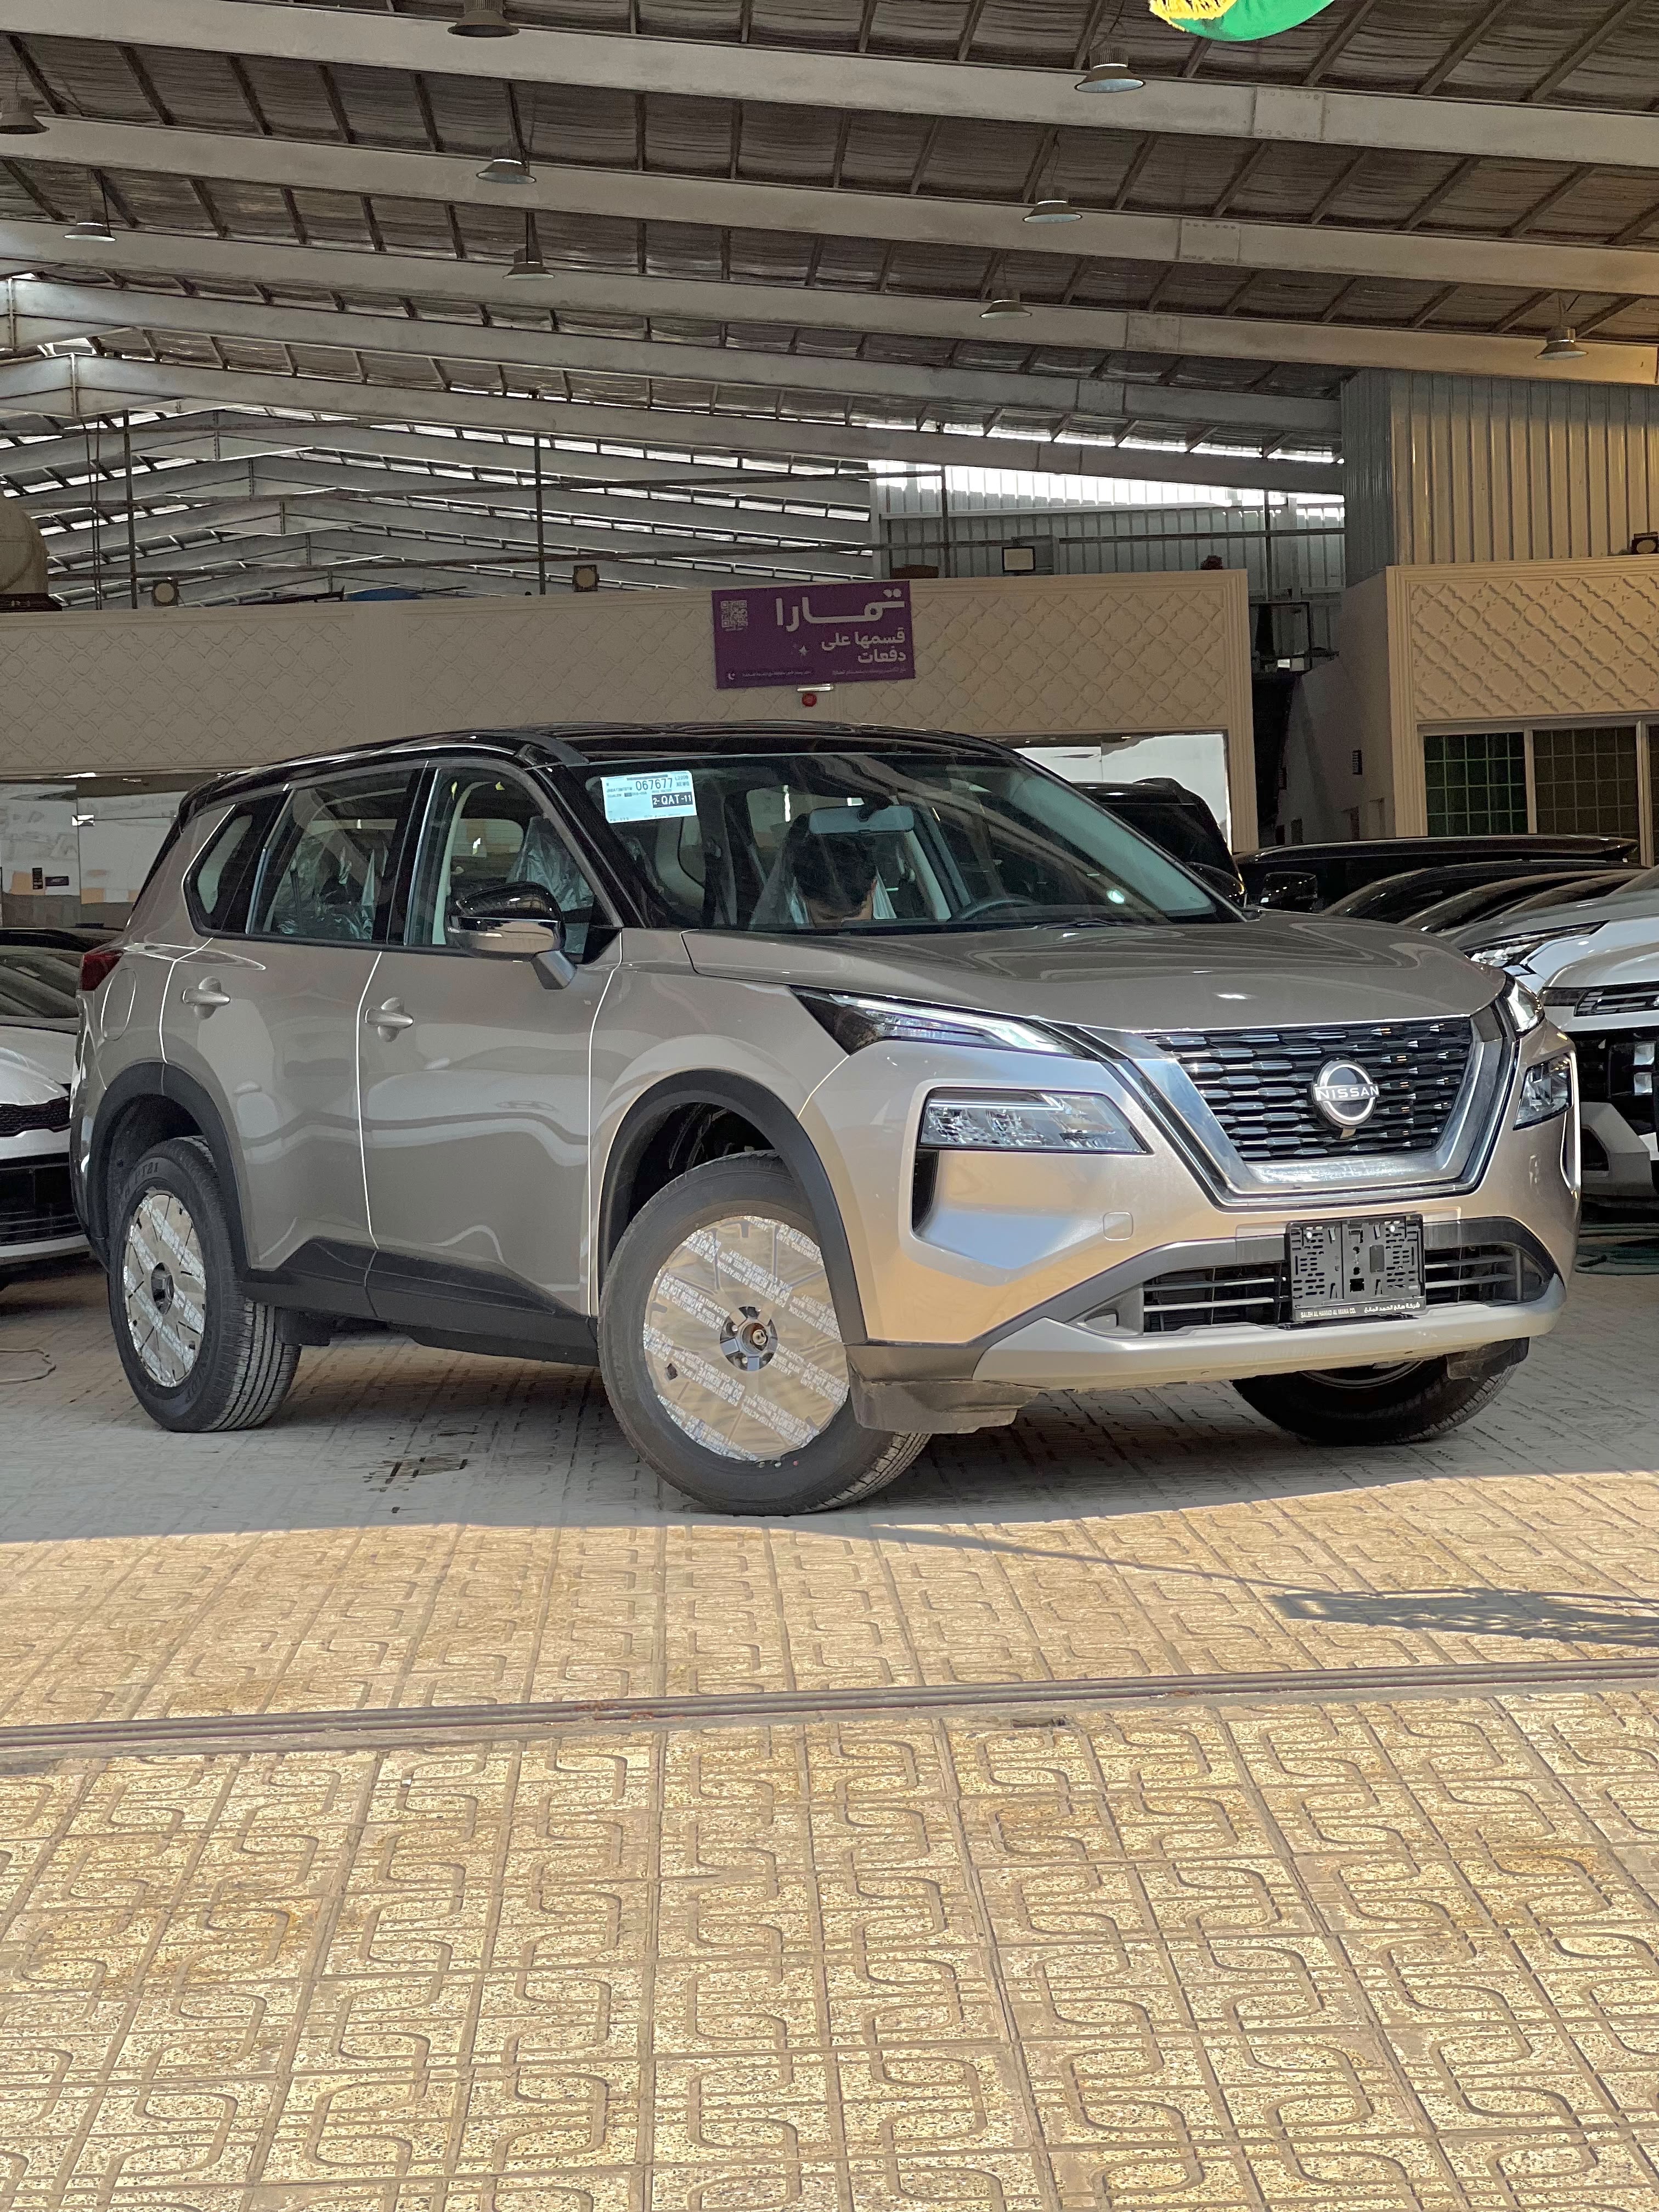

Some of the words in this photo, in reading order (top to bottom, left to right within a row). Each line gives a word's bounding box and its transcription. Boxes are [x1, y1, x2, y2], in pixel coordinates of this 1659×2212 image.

[776, 588, 905, 631] تمارا
[821, 633, 850, 651] على
[855, 627, 905, 648] قسمها
[858, 646, 906, 663] دفعات
[635, 778, 673, 791] 067677
[653, 794, 691, 805] 2-QAT-11
[1317, 1085, 1379, 1101] NISSAN
[697, 1237, 710, 1251] NOT
[708, 1244, 718, 1256] DO
[719, 1251, 733, 1263] MASK
[731, 1259, 746, 1272] WHEEL
[744, 1267, 769, 1289] REMOVE
[752, 1263, 778, 1284] CUSTOMER
[674, 1279, 698, 1298] CUSTOMER
[748, 1280, 775, 1301] CUSTOMER
[766, 1281, 781, 1296] NOT
[777, 1279, 793, 1293] UNTIL
[660, 1278, 670, 1290] DO
[668, 1284, 681, 1297] NOT
[679, 1291, 703, 1312] REMOVE
[701, 1307, 716, 1321] WHEEL
[774, 1296, 786, 1308] FOR
[778, 1289, 789, 1301] DO
[792, 1295, 805, 1308] MASK
[671, 1296, 697, 1316] CUSTOMER
[662, 1343, 672, 1355] DO
[704, 1362, 731, 1383] CUSTOMER
[787, 1361, 801, 1374] MASK
[812, 1373, 826, 1388] NOT
[806, 1362, 818, 1373] FOR
[697, 1366, 721, 1387] REMOVE
[702, 1380, 728, 1400] CUSTOMER
[720, 1380, 733, 1395] NOT
[730, 1379, 745, 1392] UNTIL
[727, 1396, 738, 1407] FOR
[732, 1388, 742, 1400] DO
[688, 1414, 699, 1425] FOR
[770, 1412, 795, 1434] REMOVE
